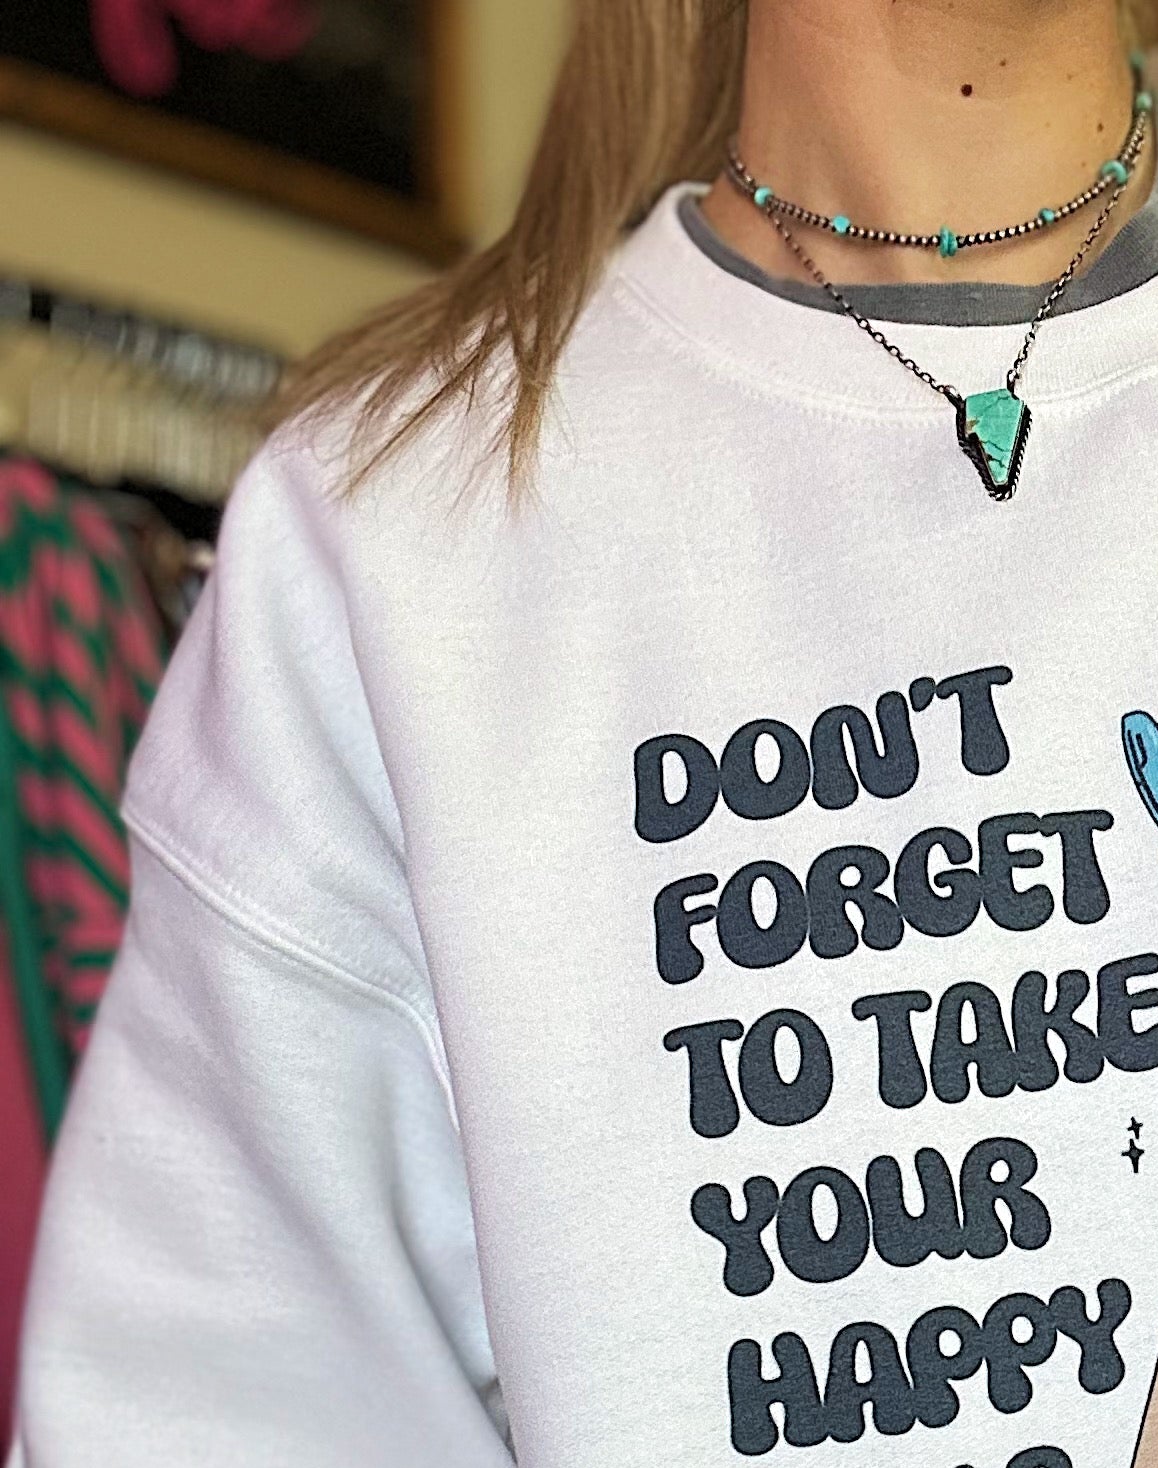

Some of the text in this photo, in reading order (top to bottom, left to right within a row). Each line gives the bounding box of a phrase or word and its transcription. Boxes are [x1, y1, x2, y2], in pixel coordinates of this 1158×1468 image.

[634, 666, 1013, 843] DON'T
[654, 810, 1114, 985] FORGET
[663, 1009, 833, 1138] TO
[691, 1137, 1051, 1297] YOUR
[728, 1278, 1132, 1456] HAPPY
